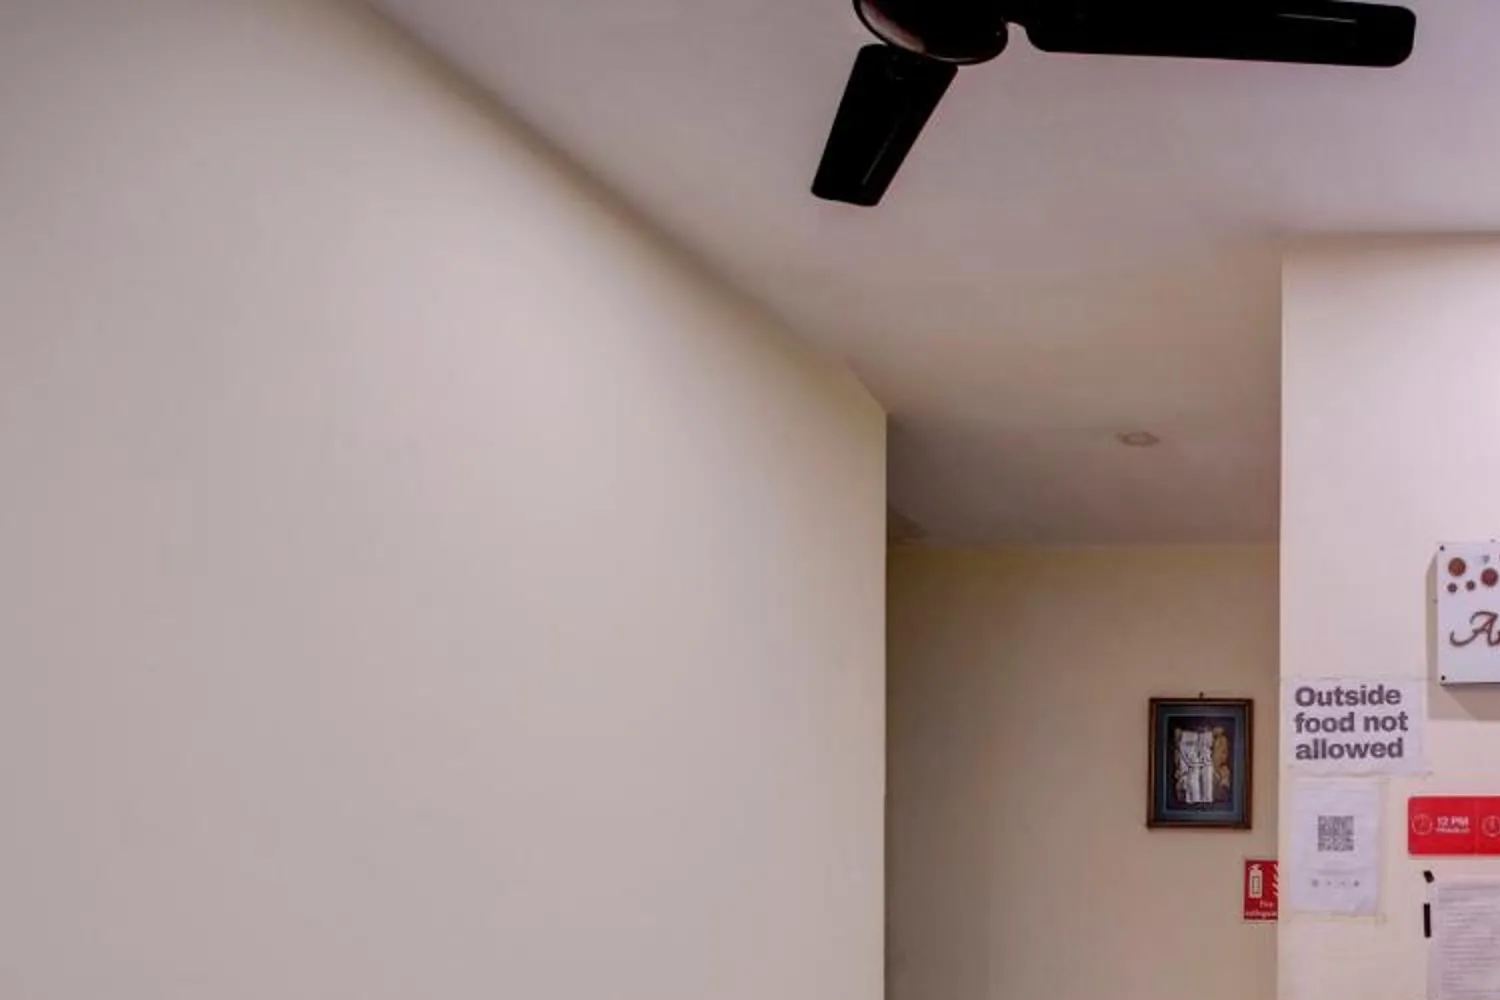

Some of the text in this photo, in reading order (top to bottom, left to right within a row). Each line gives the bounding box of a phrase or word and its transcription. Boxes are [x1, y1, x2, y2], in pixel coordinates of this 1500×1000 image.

[1295, 684, 1402, 707] Outside
[1294, 711, 1408, 734] food not
[1295, 737, 1404, 761] allowed
